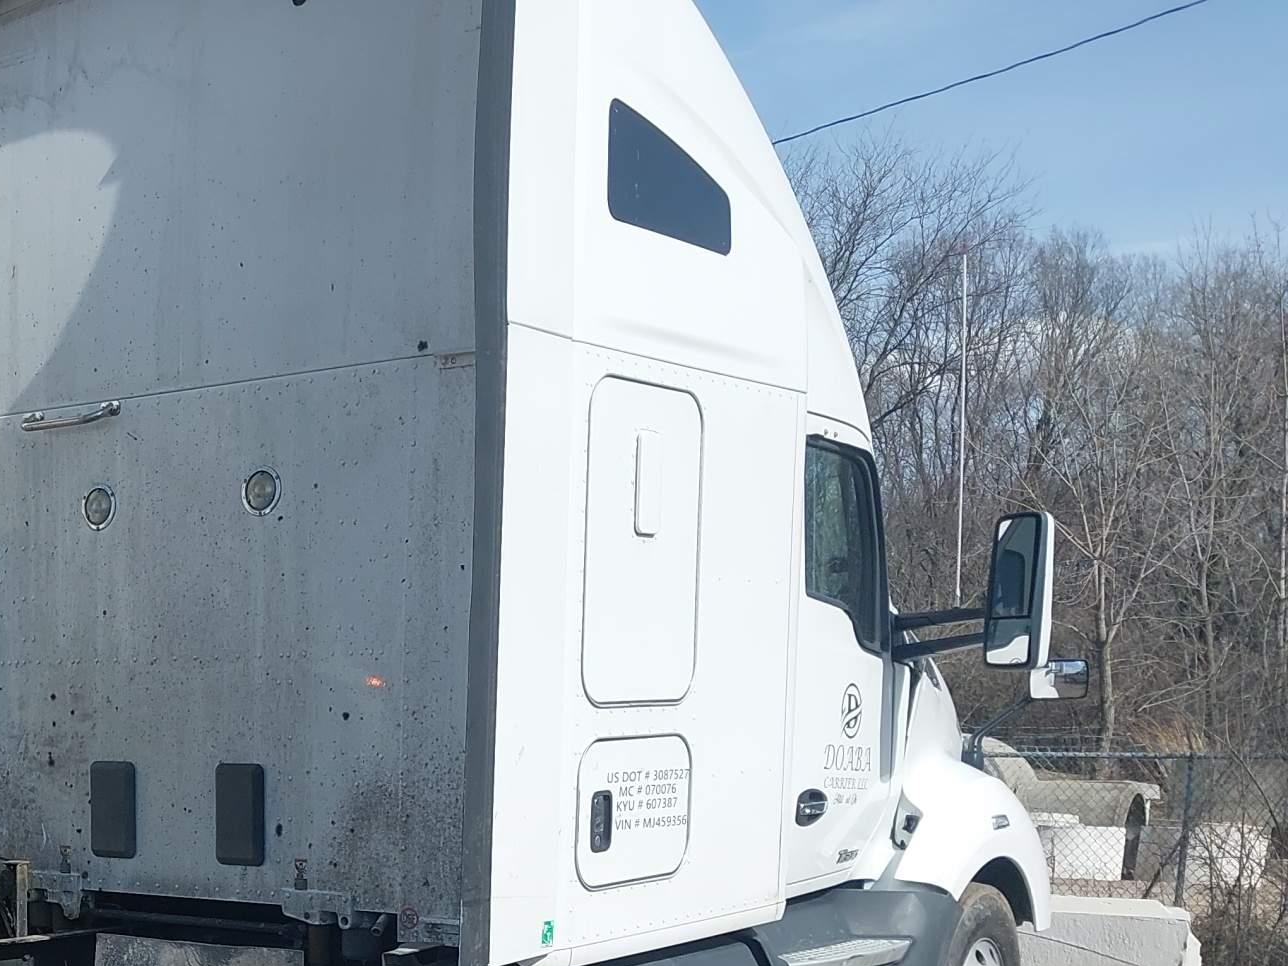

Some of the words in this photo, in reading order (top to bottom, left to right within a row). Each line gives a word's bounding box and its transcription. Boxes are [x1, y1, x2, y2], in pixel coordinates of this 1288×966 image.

[823, 744, 872, 772] DOABA
[607, 772, 620, 784] US
[622, 771, 642, 782] DOT
[653, 769, 690, 781] 3087527
[618, 785, 634, 797] MC
[645, 783, 677, 796] 070076
[616, 800, 635, 812] KYU
[646, 797, 678, 810] 607387
[615, 819, 632, 830] VIN
[642, 814, 687, 828] MJ459356
